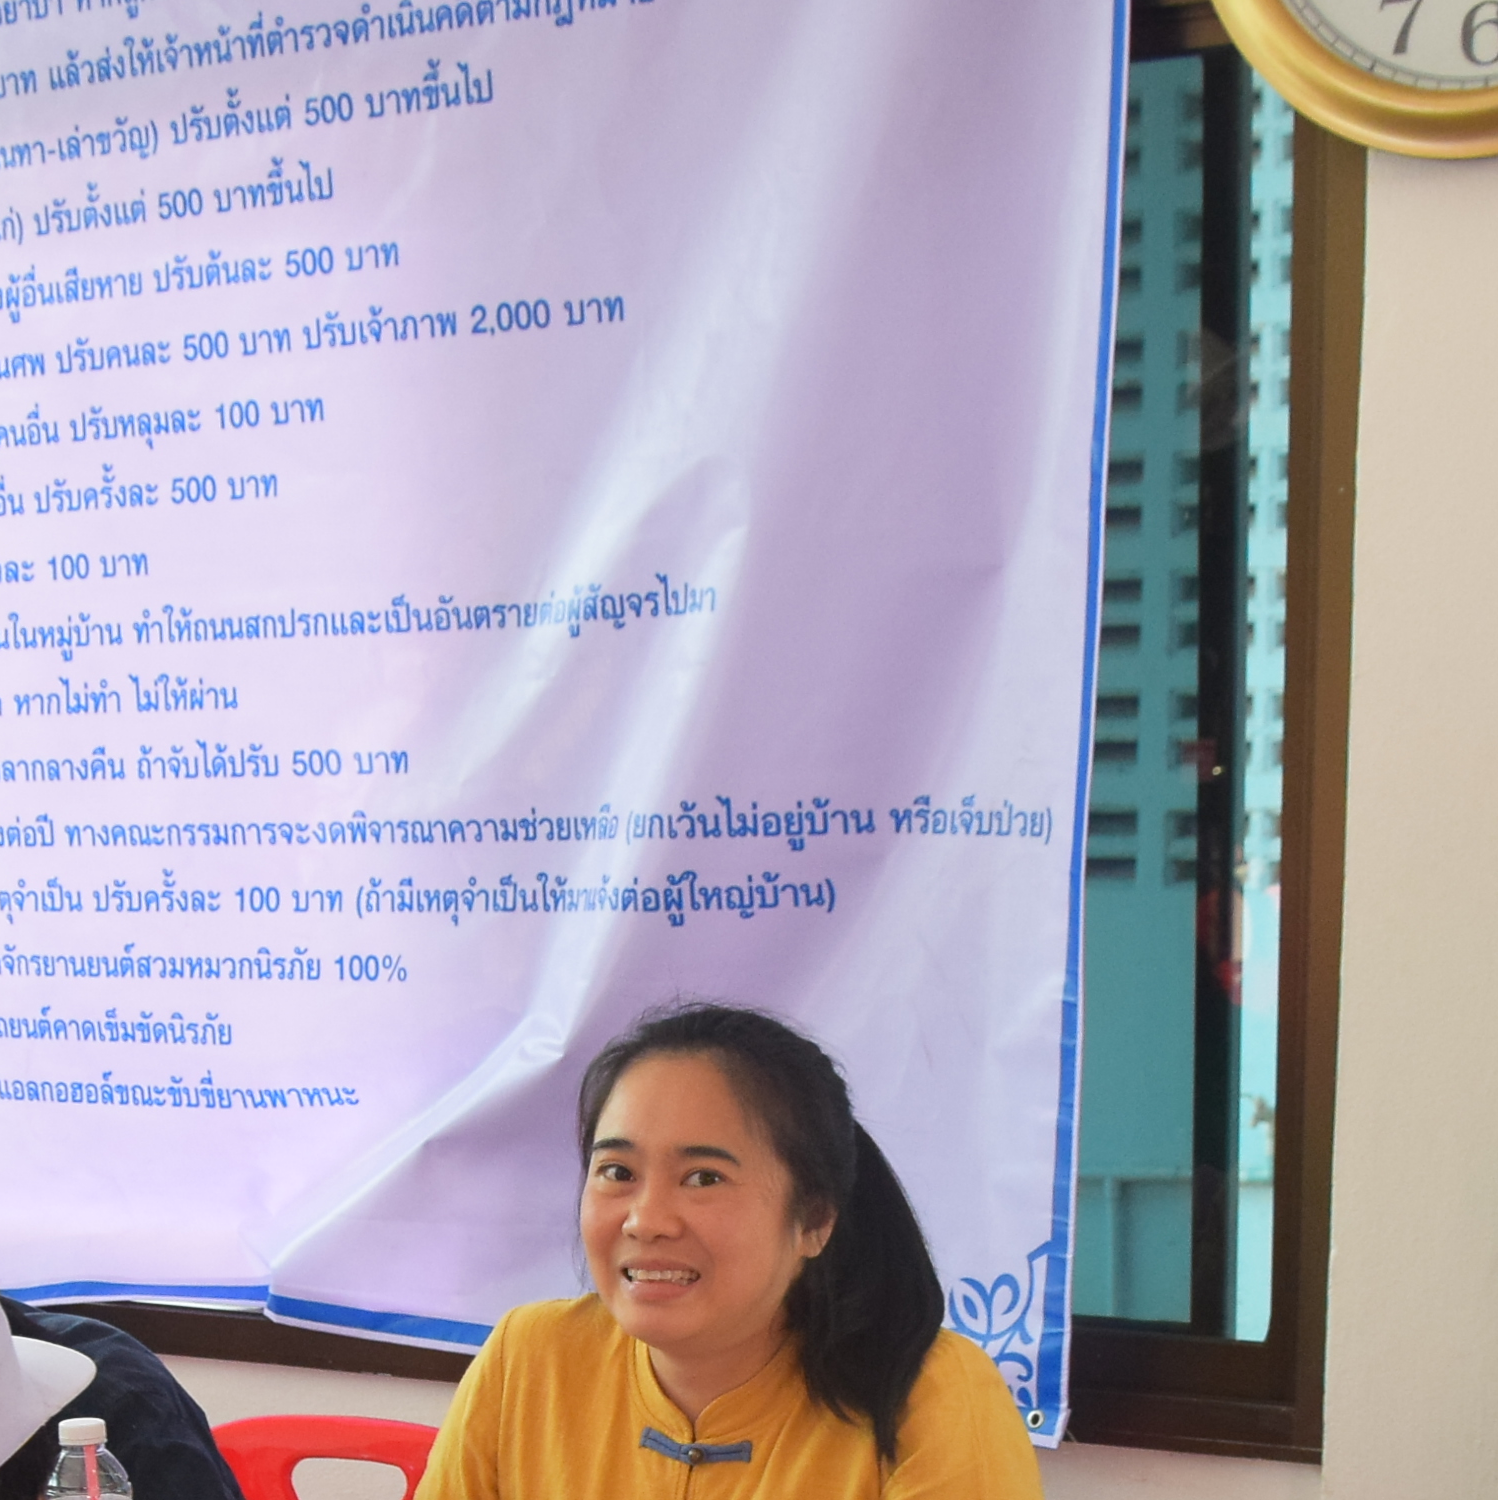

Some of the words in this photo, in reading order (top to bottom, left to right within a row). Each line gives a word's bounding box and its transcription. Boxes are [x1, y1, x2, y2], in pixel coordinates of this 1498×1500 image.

[169, 86, 292, 146] ปรับตั้งแต่
[303, 91, 355, 127] 500
[363, 57, 494, 120] บาทขึ้นไป
[32, 181, 147, 237] ปรับตั้งแต่
[157, 186, 205, 221] 500
[212, 155, 335, 214] บาทขึ้นไป
[152, 249, 273, 294] ปรับต้นละ
[284, 244, 335, 279] 500
[344, 241, 400, 273] บาท
[54, 336, 172, 375] ปรับคนละ
[182, 329, 230, 363] 500
[238, 326, 292, 357] บาท
[301, 304, 458, 351] ปรับเจ้าภาพ
[469, 297, 552, 336] 2,000
[562, 295, 626, 327] บาท
[68, 405, 202, 451] ปรับหลุมละ
[214, 398, 261, 430] 100
[269, 396, 325, 426] บาท
[33, 462, 159, 515] ปรับครั้งละ
[170, 473, 218, 506] 500
[226, 473, 279, 501] บาท
[47, 552, 91, 581] 100
[98, 552, 149, 579] บาท
[13, 676, 122, 716] หากไม่ทำ
[127, 672, 239, 713] ไม่ให้ผ่าน
[136, 738, 280, 780] ถ้าจับได้ปรับ
[291, 748, 343, 778] 500
[353, 749, 410, 776] บาท
[888, 794, 1054, 845] หรือเจ็บป่วย)
[92, 868, 222, 913] ปรับครั้งละ
[234, 885, 282, 914] 100
[290, 888, 344, 914] บาท
[333, 953, 409, 983] 100%
